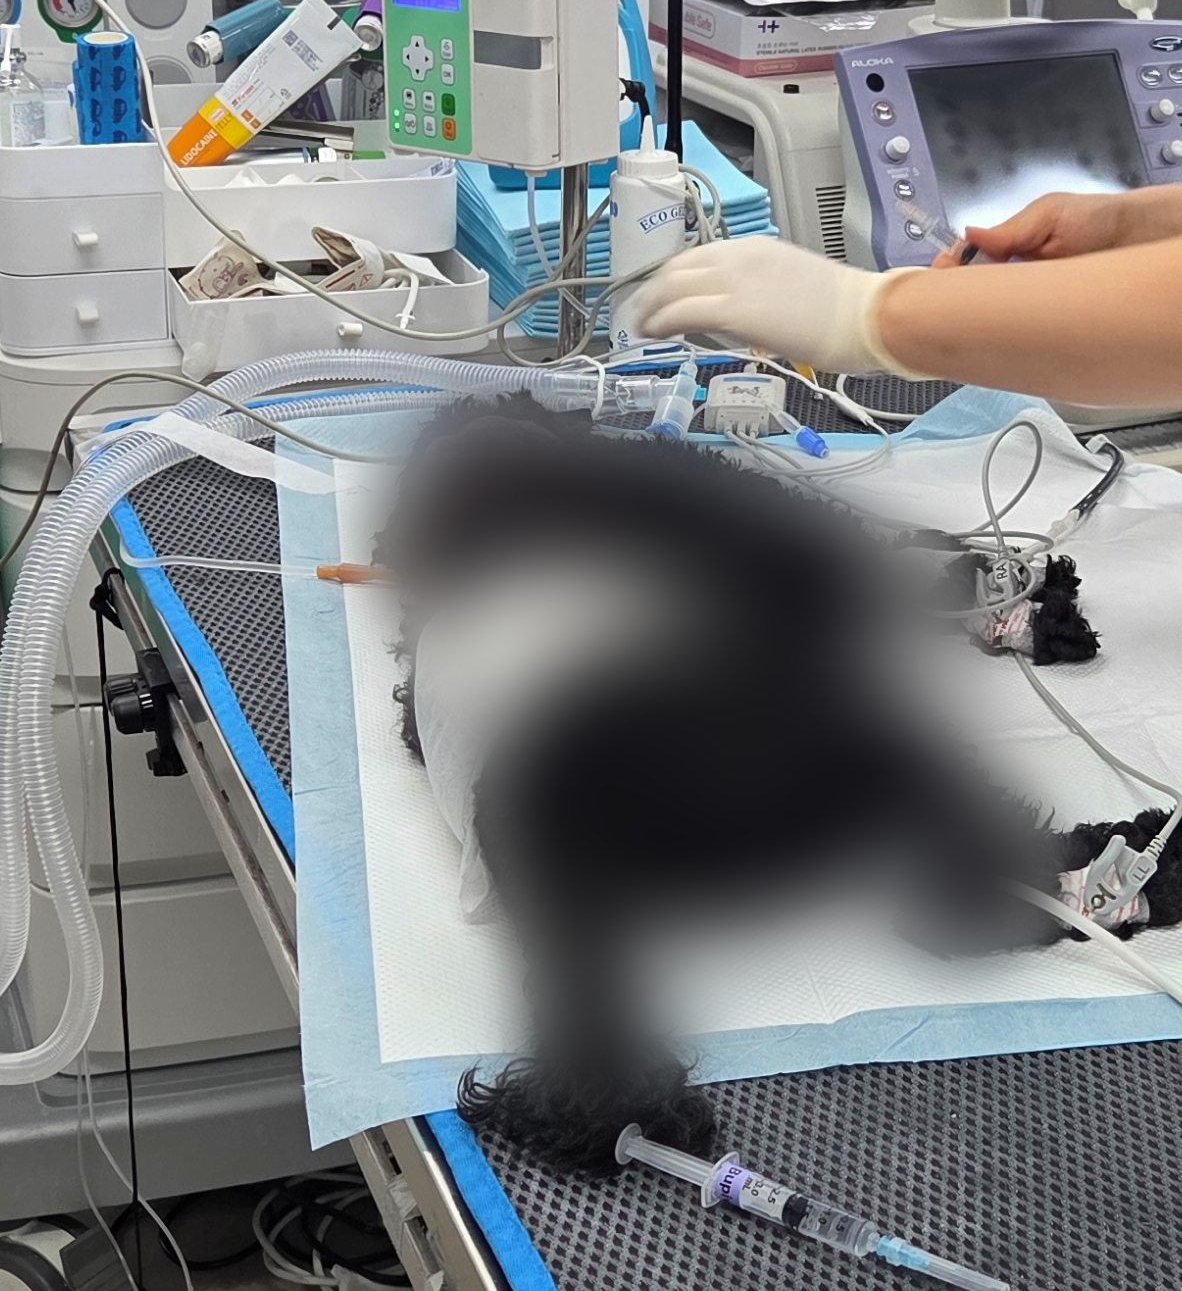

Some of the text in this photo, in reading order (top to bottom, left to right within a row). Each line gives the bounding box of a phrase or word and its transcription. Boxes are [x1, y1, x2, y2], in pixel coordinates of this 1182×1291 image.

[851, 57, 894, 68] ALOKA
[180, 128, 218, 166] LIDOCAINE
[639, 211, 667, 231] ECO
[996, 562, 1008, 580] RA
[1132, 867, 1150, 882] LL
[751, 1179, 764, 1197] 3.0
[768, 1188, 780, 1205] 2.5
